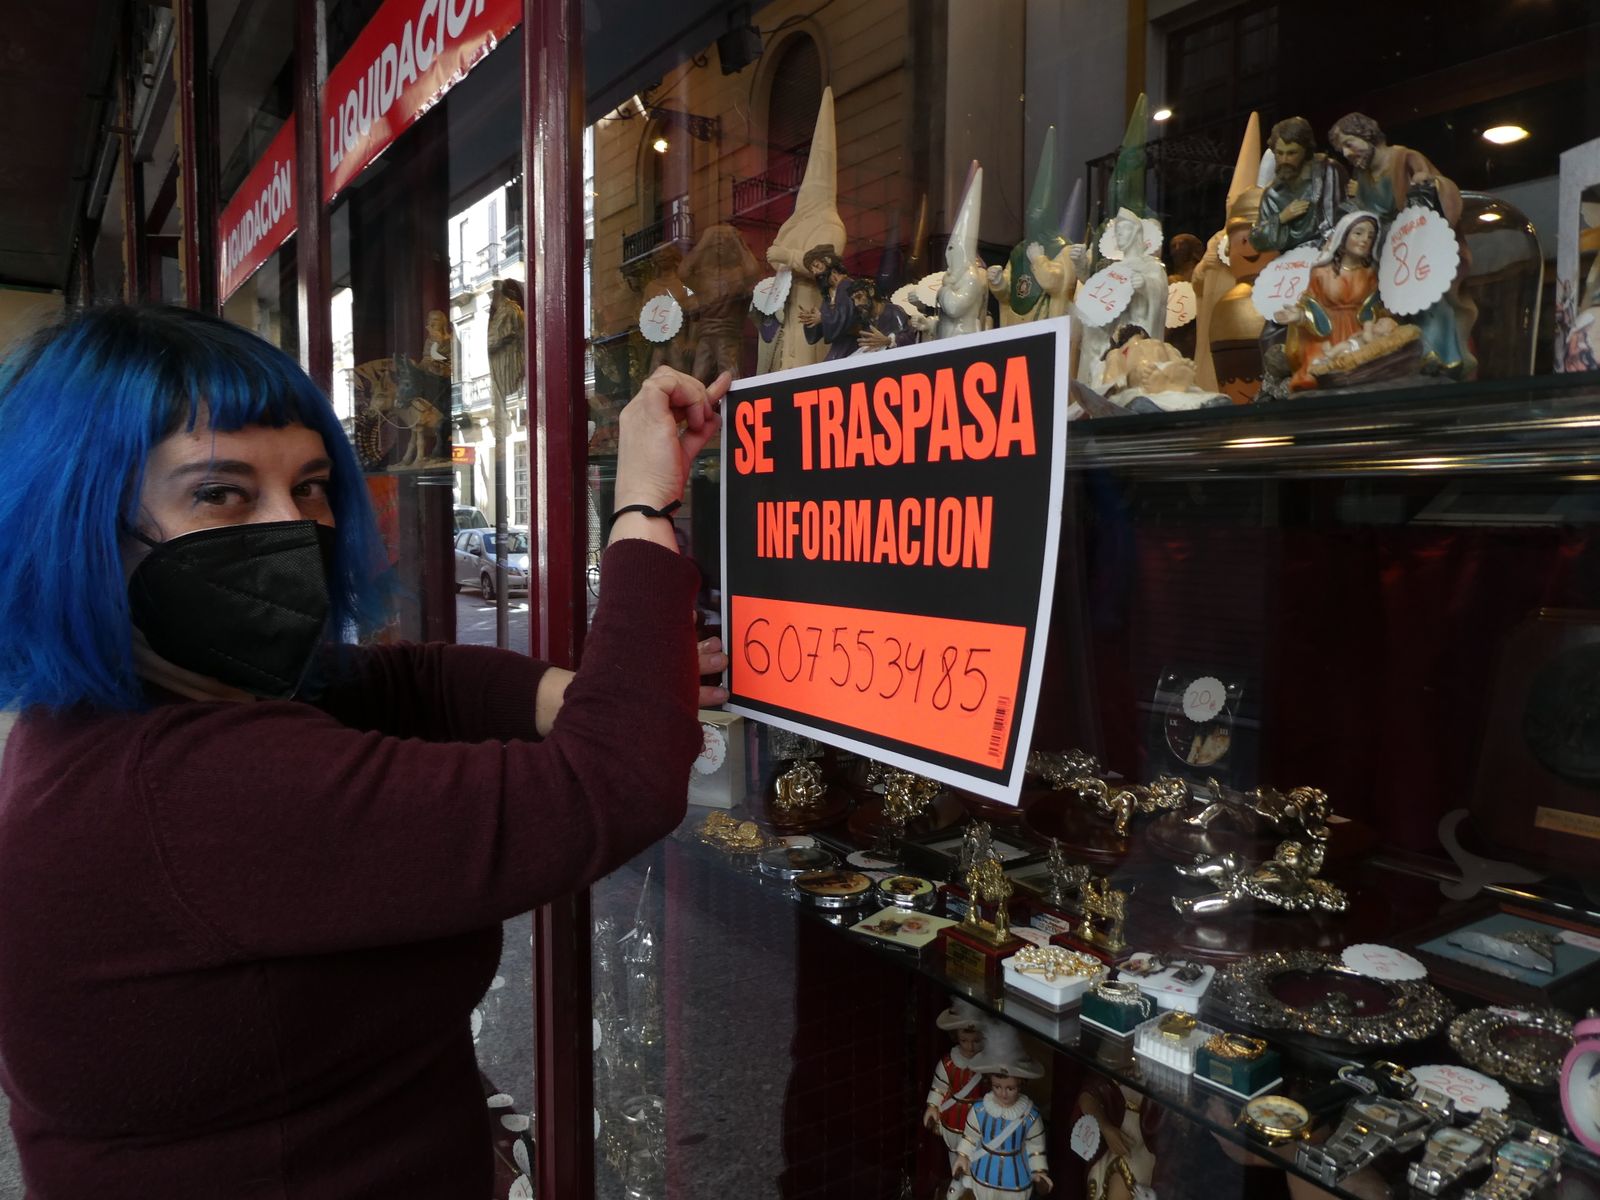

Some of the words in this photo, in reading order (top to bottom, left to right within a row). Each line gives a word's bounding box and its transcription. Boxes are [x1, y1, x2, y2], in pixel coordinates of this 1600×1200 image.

[734, 397, 775, 475] SE
[793, 355, 1037, 471] TRASPASA
[756, 496, 994, 569] INFORMACION
[743, 617, 992, 712] 607553485
